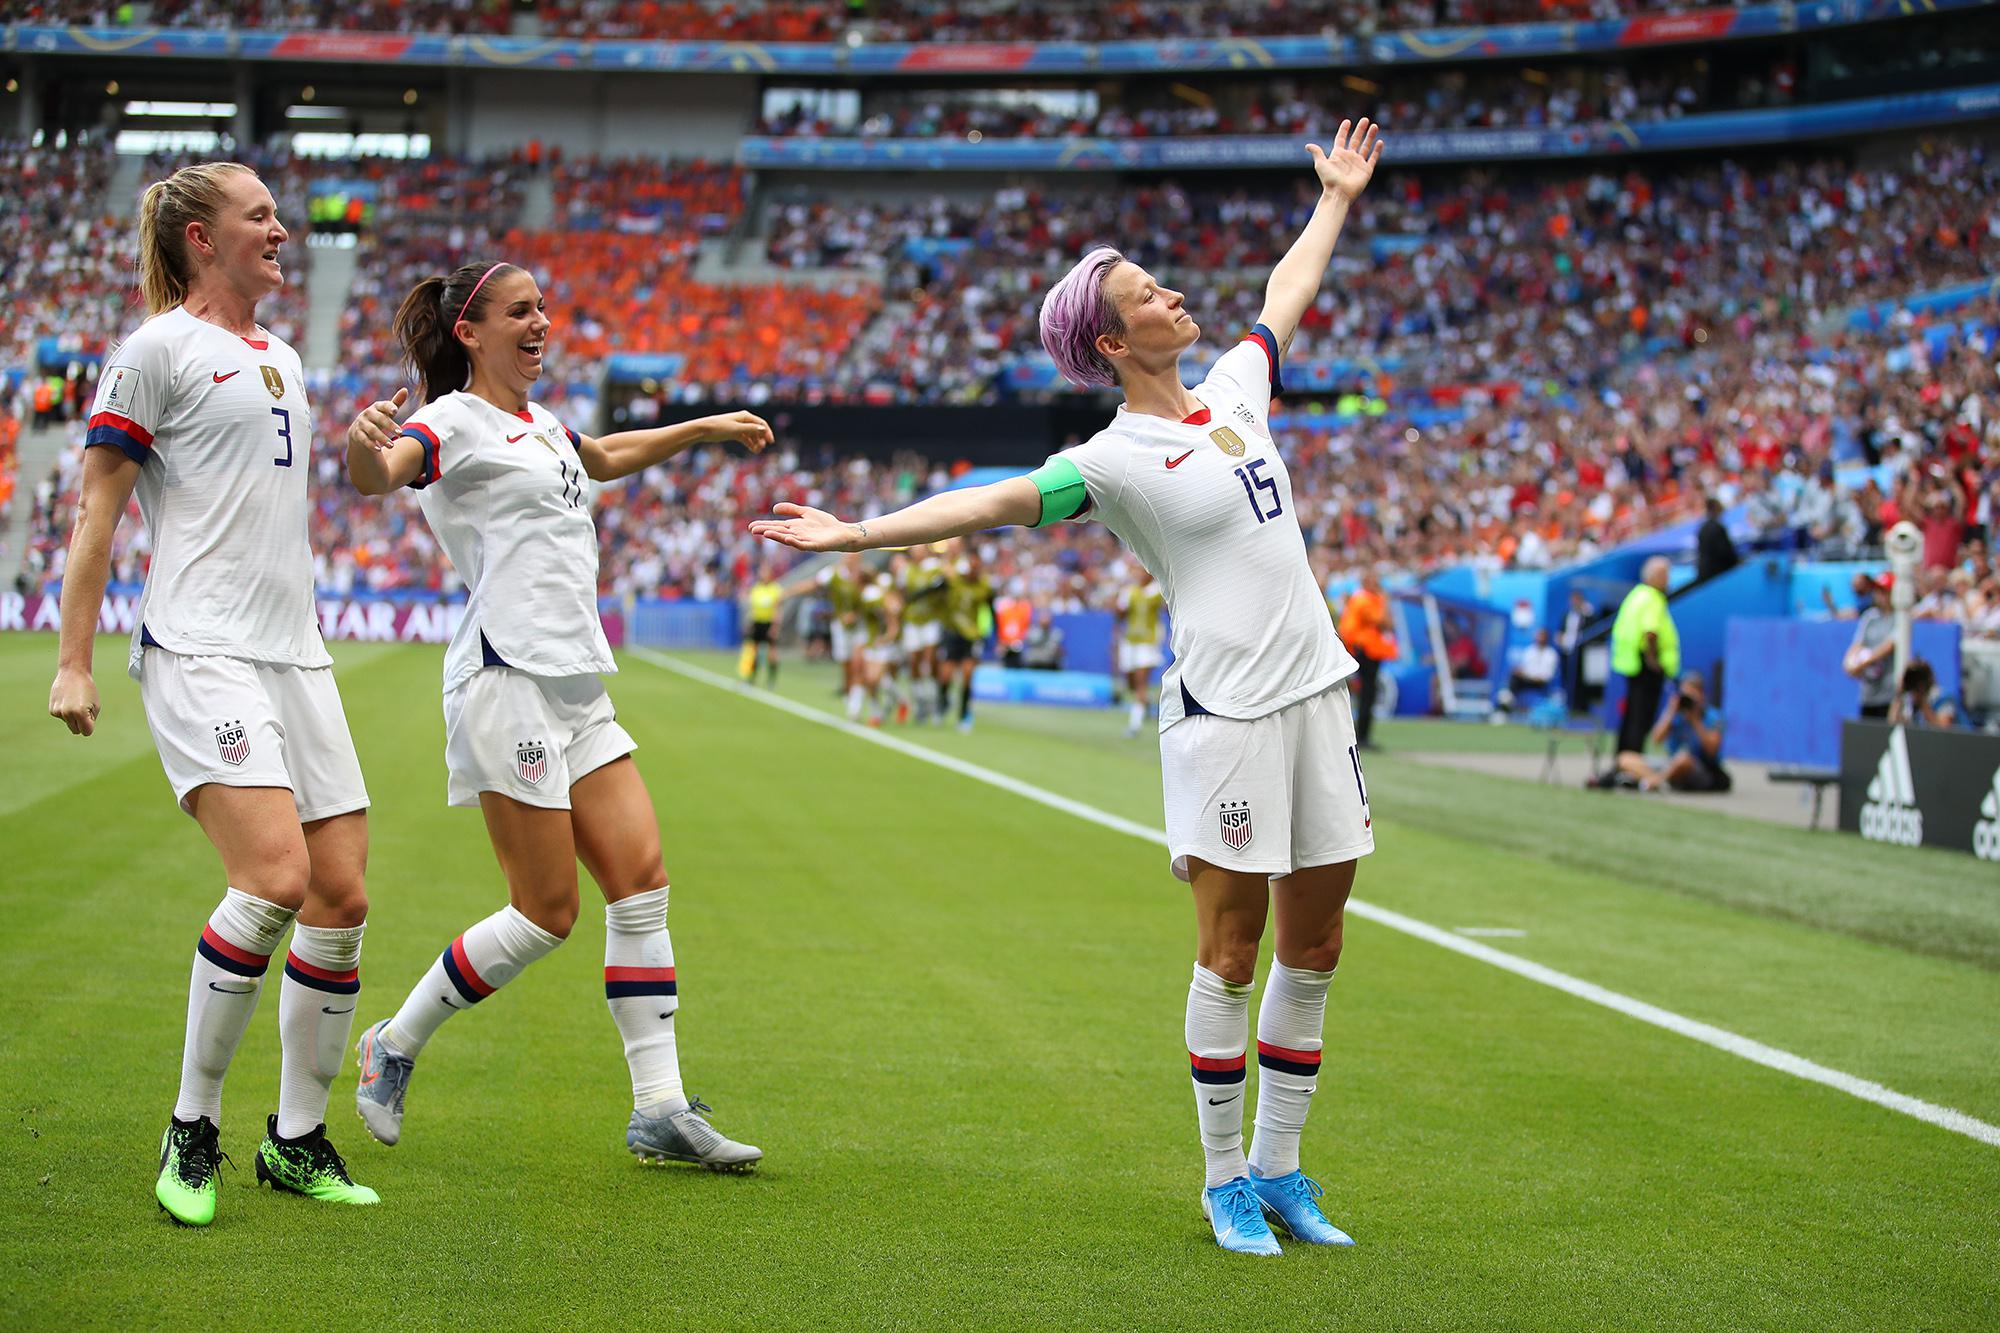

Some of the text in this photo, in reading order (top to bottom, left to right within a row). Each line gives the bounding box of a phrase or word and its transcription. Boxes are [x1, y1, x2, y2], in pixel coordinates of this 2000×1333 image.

[271, 407, 293, 468] 3
[1234, 458, 1283, 524] 15
[219, 729, 244, 746] USA
[520, 750, 543, 765] USA
[1222, 811, 1248, 828] USA
[1859, 800, 1924, 848] adidas
